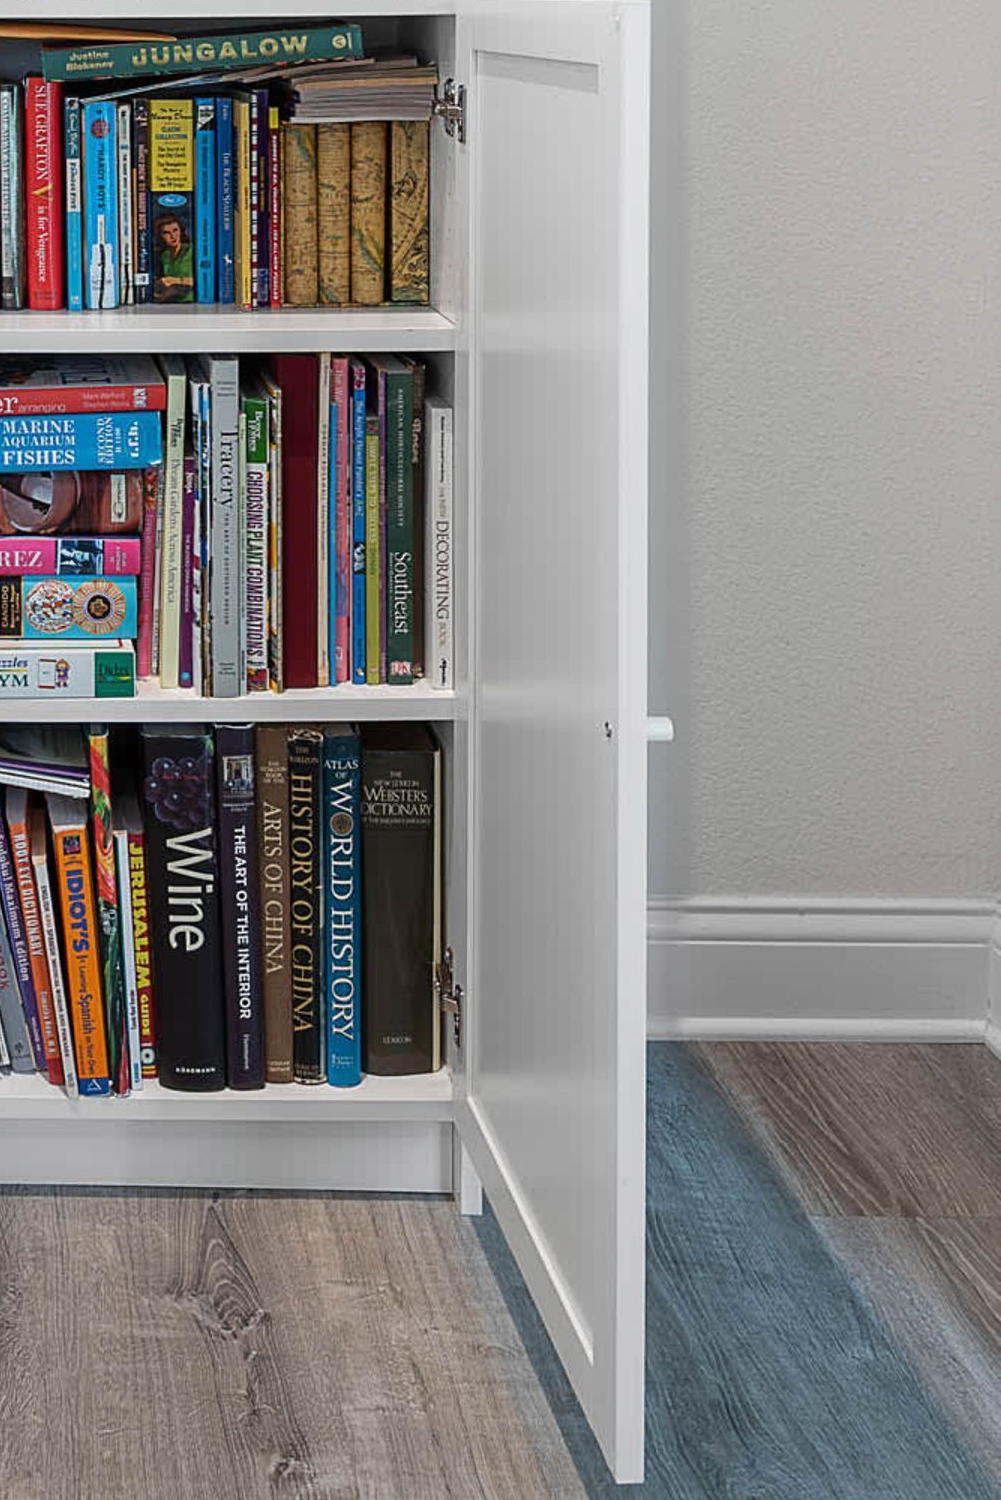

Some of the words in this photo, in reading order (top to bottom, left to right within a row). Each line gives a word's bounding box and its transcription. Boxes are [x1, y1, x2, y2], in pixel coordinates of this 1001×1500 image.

[130, 35, 308, 67] JUNGALOW
[35, 85, 48, 111] SUE
[35, 114, 49, 180] GRAFTON
[37, 217, 48, 229] for
[36, 232, 48, 282] Vengeance
[2, 435, 76, 448] AQUARIUM
[3, 419, 76, 434] MARINE
[4, 449, 75, 466] FISHES
[214, 425, 239, 509] Tracery
[169, 491, 180, 530] Gardens
[246, 472, 263, 528] CHOOSING
[246, 531, 263, 566] PLANT
[436, 521, 449, 619] DECORATING
[167, 564, 178, 603] America
[394, 552, 412, 634] Southeast
[246, 568, 263, 656] COMBINATIONS
[324, 758, 359, 769] ATLAS
[234, 825, 246, 853] THE
[263, 801, 281, 857] ARTS
[291, 774, 313, 893] HISTORY
[165, 827, 214, 953] Wine
[234, 856, 247, 882] ART
[264, 863, 282, 893] OF
[22, 889, 44, 957] DICTIONARY
[235, 891, 248, 911] OF
[292, 901, 313, 934] OF
[4, 883, 21, 939] Maximum
[14, 941, 31, 982] Edition
[65, 869, 90, 952] IDIOT'S
[78, 994, 97, 1035] Spanish
[128, 842, 151, 989] JERUSALEM
[140, 994, 151, 1035] GUIDE
[236, 915, 248, 945] THE
[265, 901, 284, 974] CHINA
[237, 949, 251, 1019] INTERIOR
[292, 944, 314, 1032] CHINA
[331, 907, 354, 1041] HISTORY
